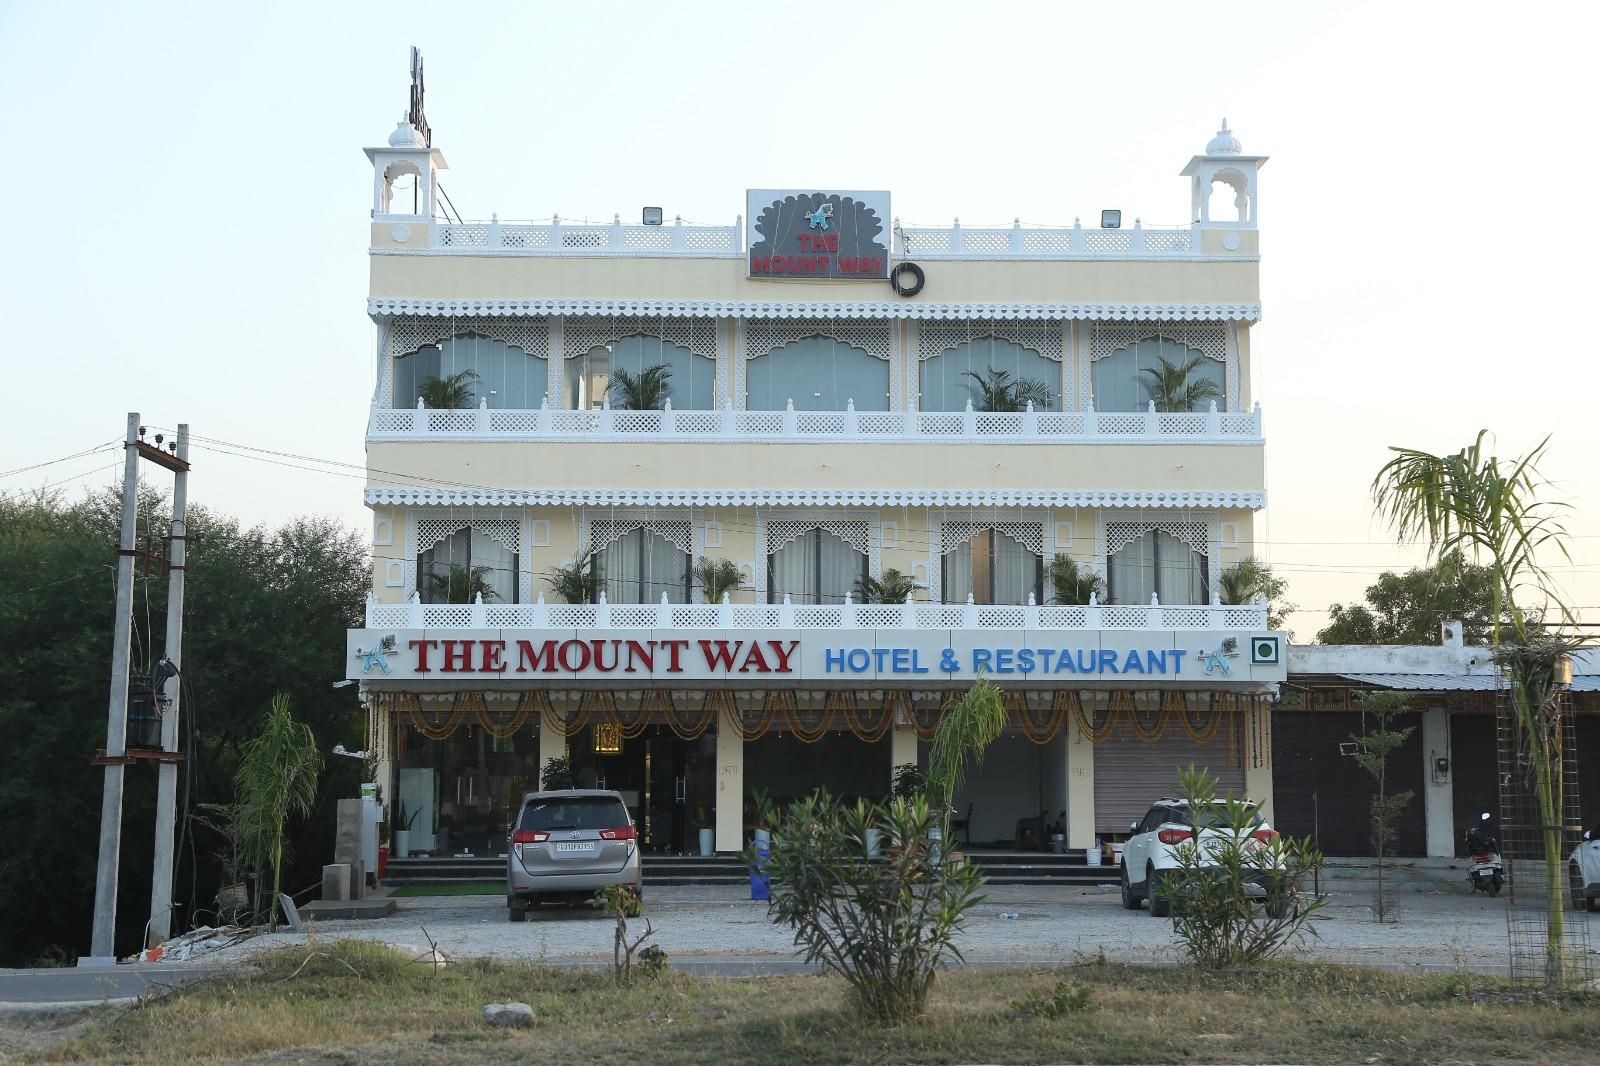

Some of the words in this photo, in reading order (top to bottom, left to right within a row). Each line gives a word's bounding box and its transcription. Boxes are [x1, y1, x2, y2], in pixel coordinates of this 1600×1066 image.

[798, 233, 840, 252] THE
[752, 255, 831, 274] MOUNT
[838, 255, 884, 274] WAY
[408, 639, 506, 673] THE
[515, 639, 690, 673] MOUNT
[698, 639, 800, 673] WAY
[825, 647, 929, 673] HOTEL
[939, 648, 961, 673] &
[972, 648, 1187, 674] RESTAURANT
